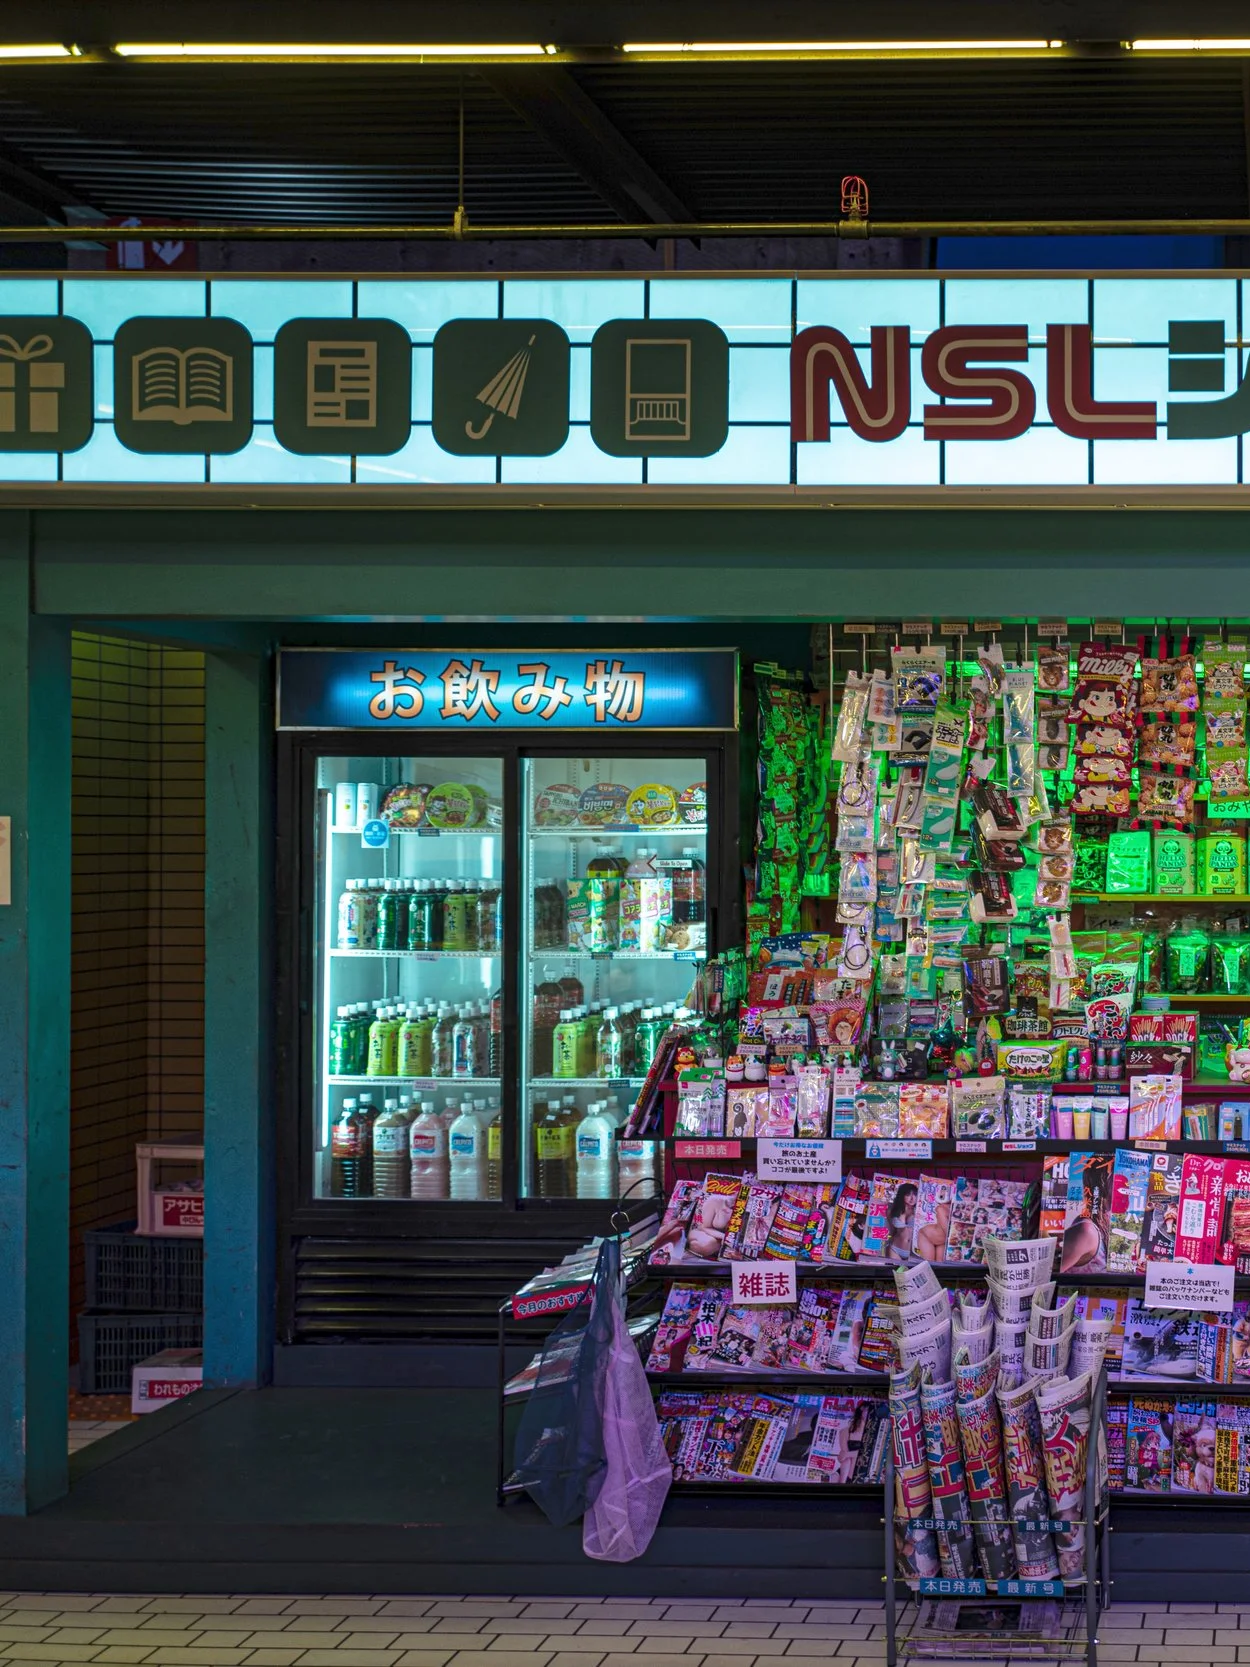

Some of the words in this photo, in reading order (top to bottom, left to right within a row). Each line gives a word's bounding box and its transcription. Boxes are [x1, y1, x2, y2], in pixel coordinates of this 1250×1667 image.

[1080, 656, 1133, 683] Milky
[369, 660, 645, 722] お飲み物
[1007, 1020, 1048, 1033] 珈琲茶館
[1009, 1054, 1050, 1065] たけのこの里
[685, 1144, 727, 1155] 本日発売
[782, 1150, 817, 1158] 旅のお土産
[763, 1157, 836, 1166] 買い忘れていませんか?
[1189, 1159, 1202, 1167] Dr.
[771, 1166, 828, 1174] ココが最後ですよ!
[1153, 1172, 1164, 1191] 絶品
[164, 1199, 204, 1212] アサヒ
[739, 1272, 790, 1298] 雑誌
[1160, 1278, 1220, 1287] 本のご注文は当店で!
[802, 1291, 817, 1301] NG
[1149, 1285, 1230, 1296] 雑誌のバックナンバーなども
[518, 1288, 594, 1314] 今月のおすすめ!
[1159, 1293, 1218, 1303] ご注文いただけます。
[913, 1520, 958, 1530] 本日発売
[1026, 1521, 1063, 1531] 最新号
[925, 1581, 981, 1593] 本日発売
[1007, 1582, 1054, 1594] 最新号
